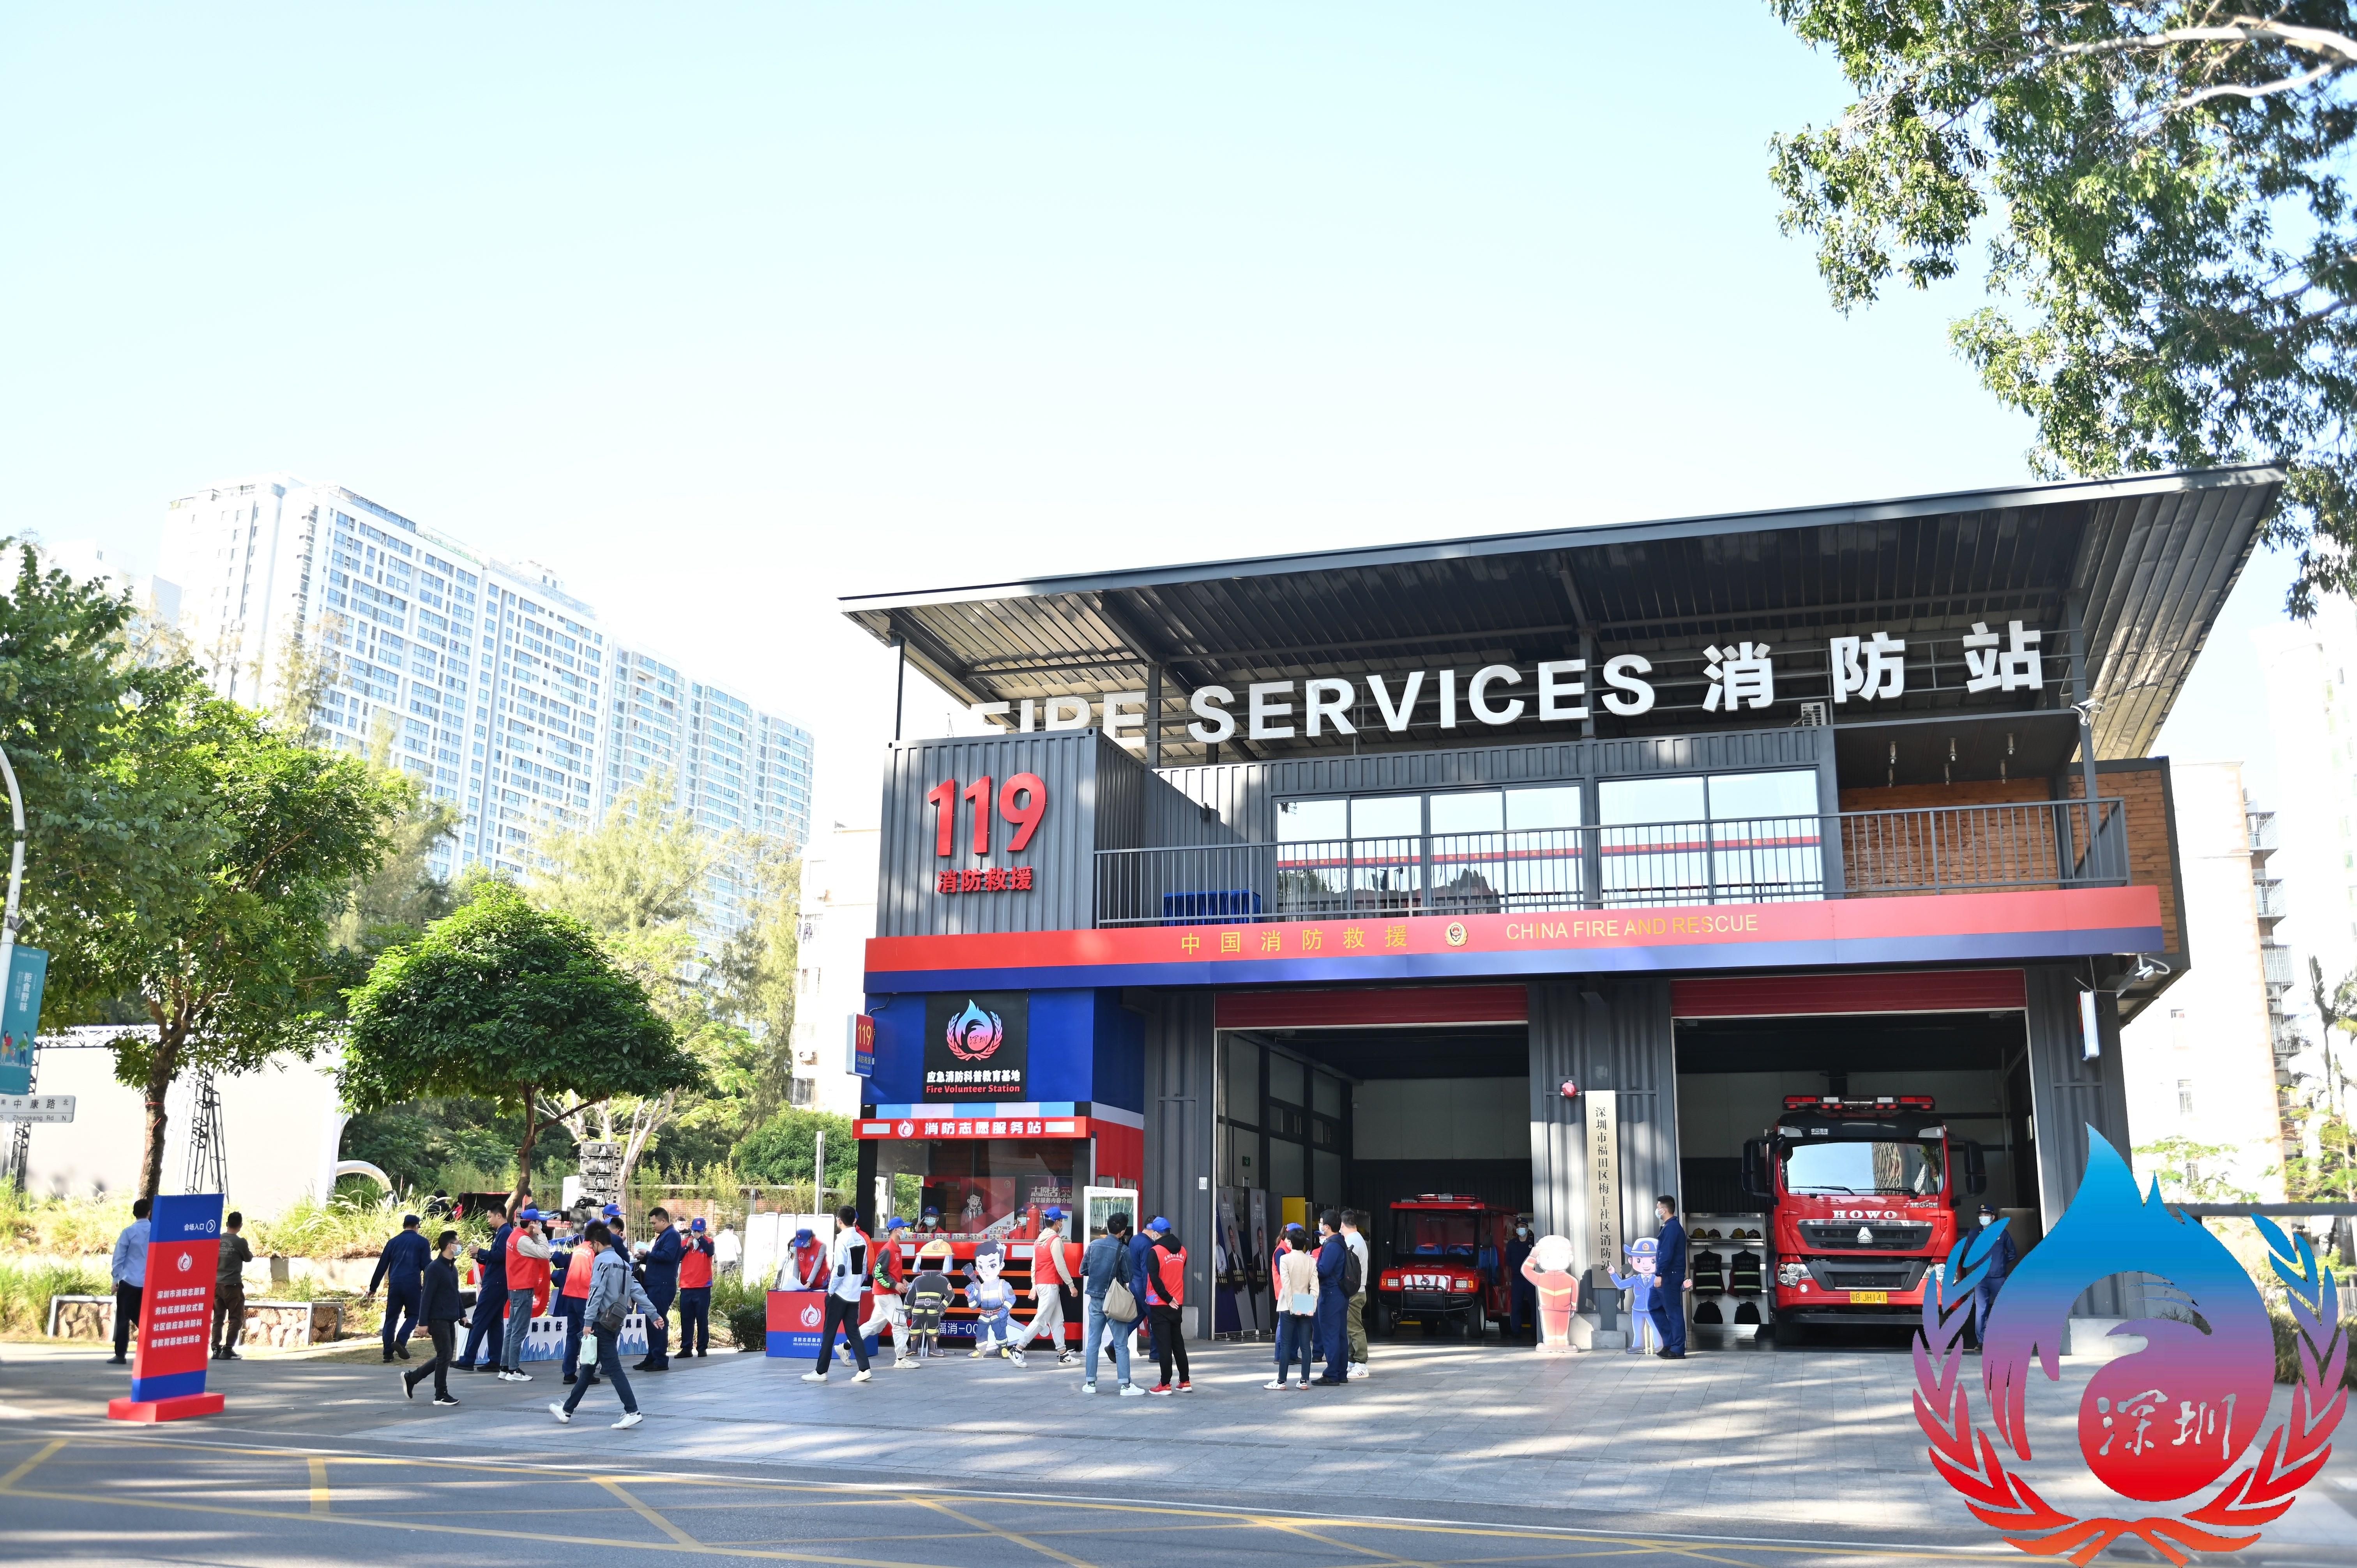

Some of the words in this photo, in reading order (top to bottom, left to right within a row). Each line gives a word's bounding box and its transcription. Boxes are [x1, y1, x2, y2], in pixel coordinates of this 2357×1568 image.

[1701, 619, 2045, 713] 消防站
[971, 692, 1146, 749] FIRE
[1188, 653, 1656, 745] SERVICES
[928, 772, 1047, 856] 119
[936, 865, 1033, 894] 消防救援
[1506, 921, 1568, 941] CHINA
[1574, 919, 1619, 938] FIRE
[1625, 917, 1667, 936] AND
[1671, 913, 1759, 934] RESCUE
[1180, 924, 1408, 955] 中国消防救援
[19, 972, 33, 1012] 拒食野味
[858, 1024, 872, 1045] 119
[970, 1035, 988, 1045] 深圳
[857, 1054, 871, 1065] 消防救援
[926, 1070, 1020, 1083] 应急消防科普教育基地
[926, 1084, 943, 1093] Fire
[944, 1084, 986, 1093] Volunteer
[988, 1083, 1020, 1092] Station
[14, 1098, 56, 1109] 中康路
[925, 1121, 1041, 1134] 消防志愿服务站
[1031, 1186, 1059, 1197] 志愿者
[1832, 1210, 1897, 1219] HOWO
[157, 1287, 205, 1299] 深圳市消防志愿服
[155, 1303, 204, 1315] 务队伍授旗仪式暨
[153, 1319, 202, 1331] 社区级应急消防科
[152, 1335, 200, 1348] 普教育基地现场会
